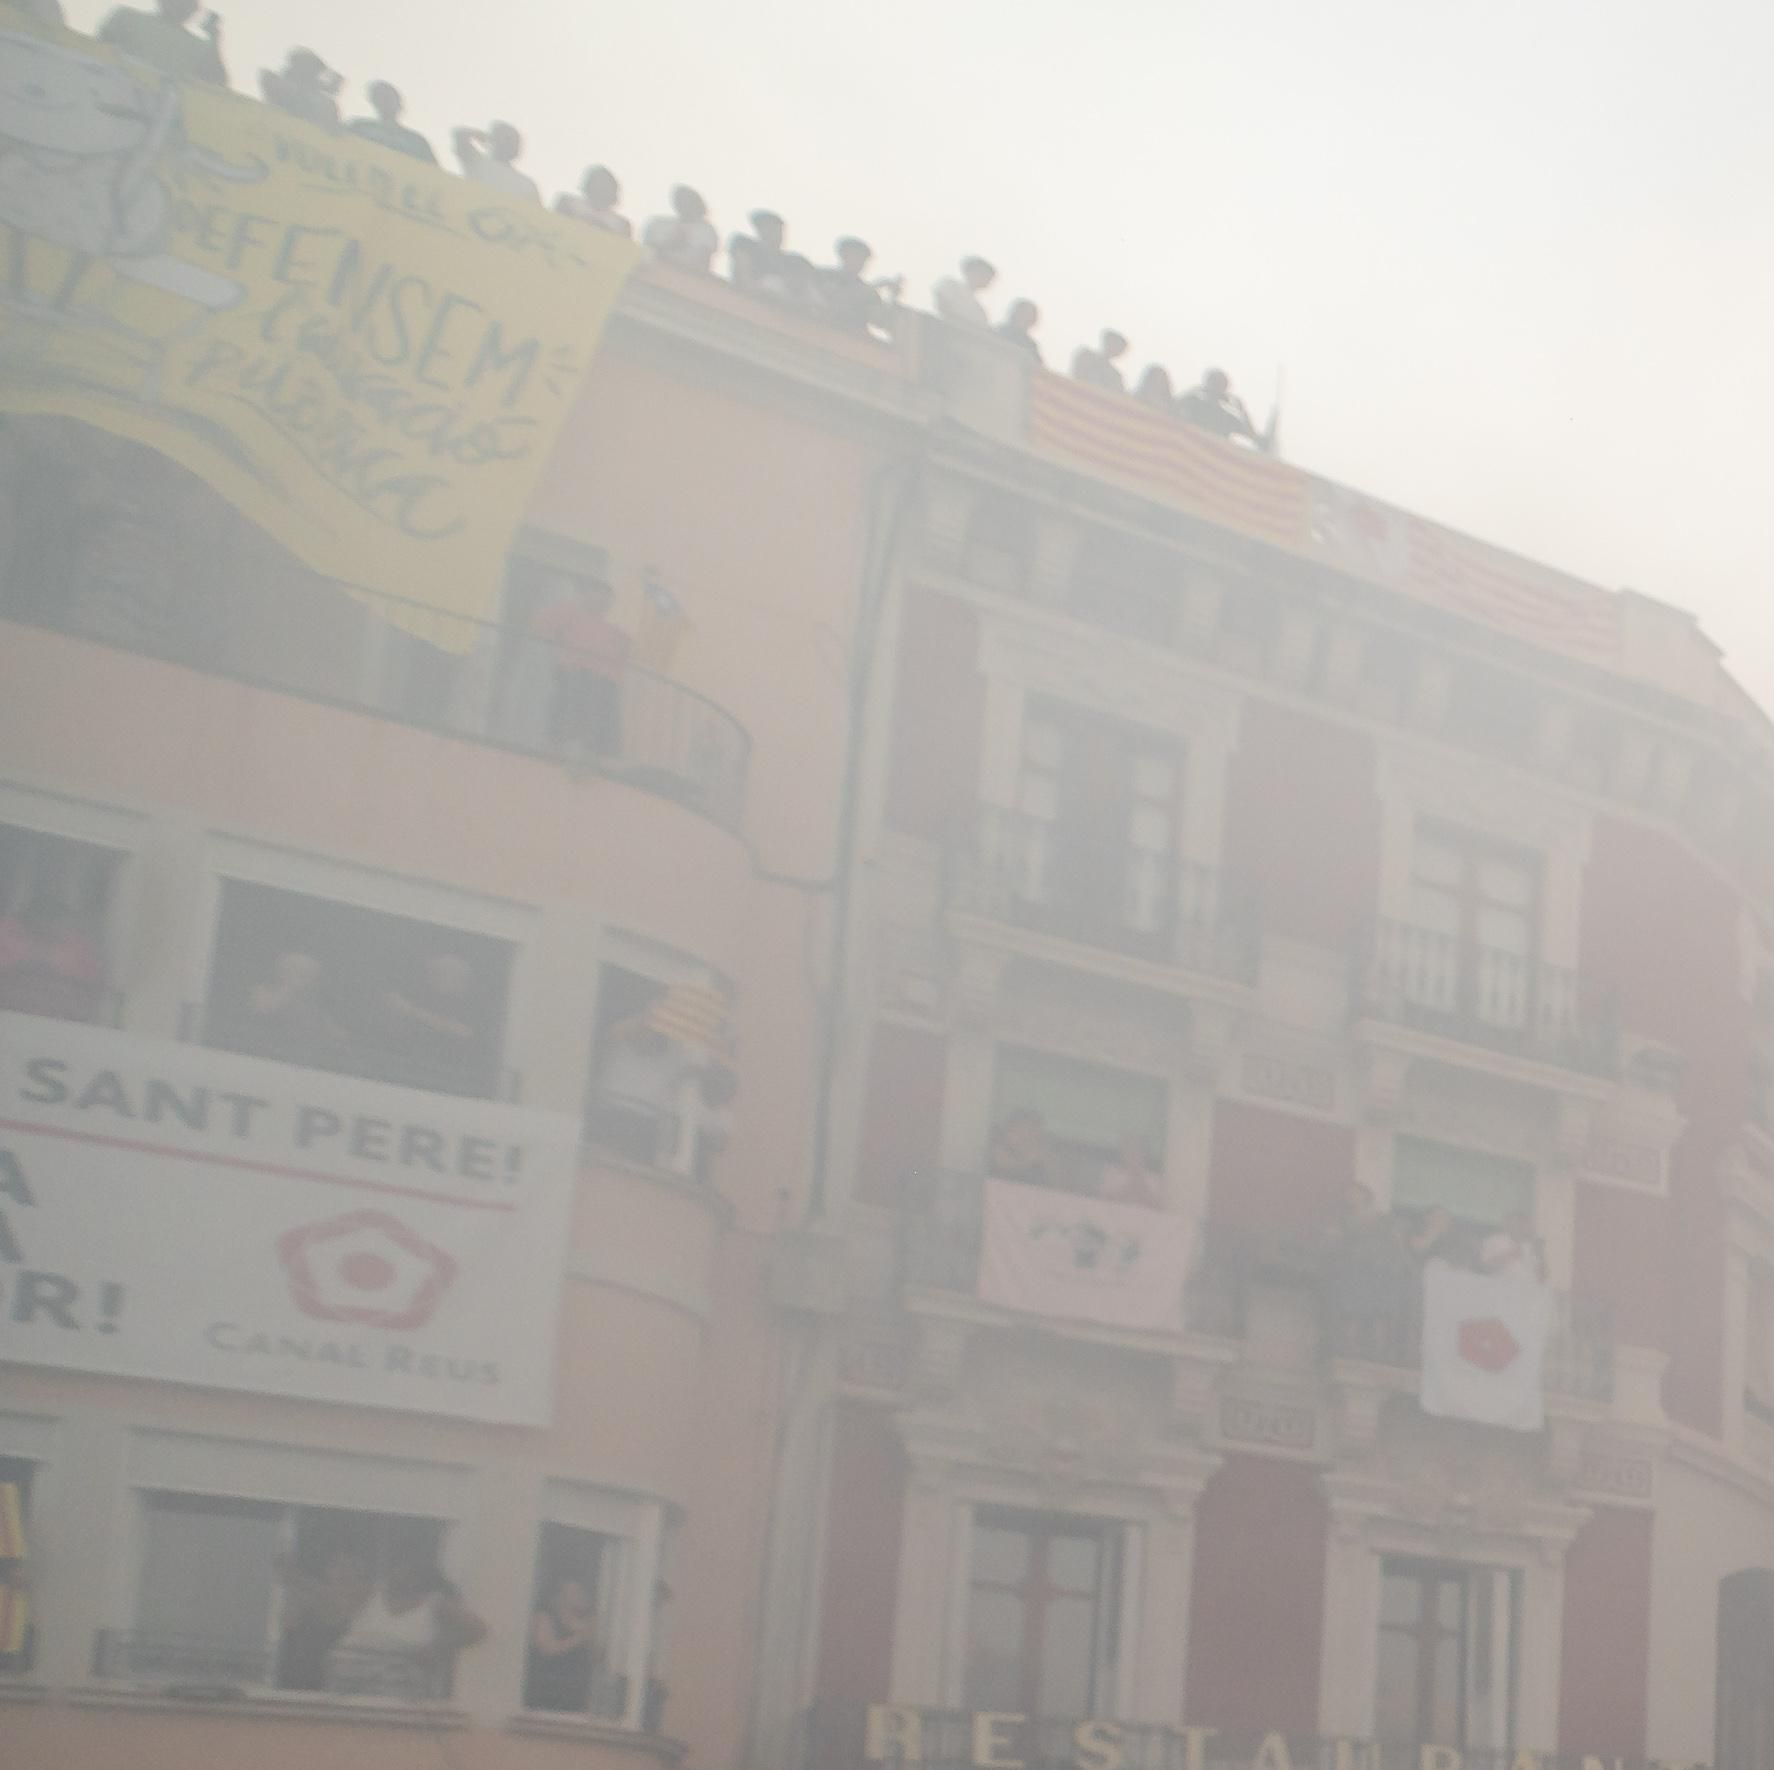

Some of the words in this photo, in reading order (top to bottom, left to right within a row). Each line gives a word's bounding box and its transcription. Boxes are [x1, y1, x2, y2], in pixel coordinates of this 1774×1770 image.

[19, 1057, 268, 1138] SANT
[293, 1103, 522, 1184] PERE!
[0, 1269, 127, 1333] R!
